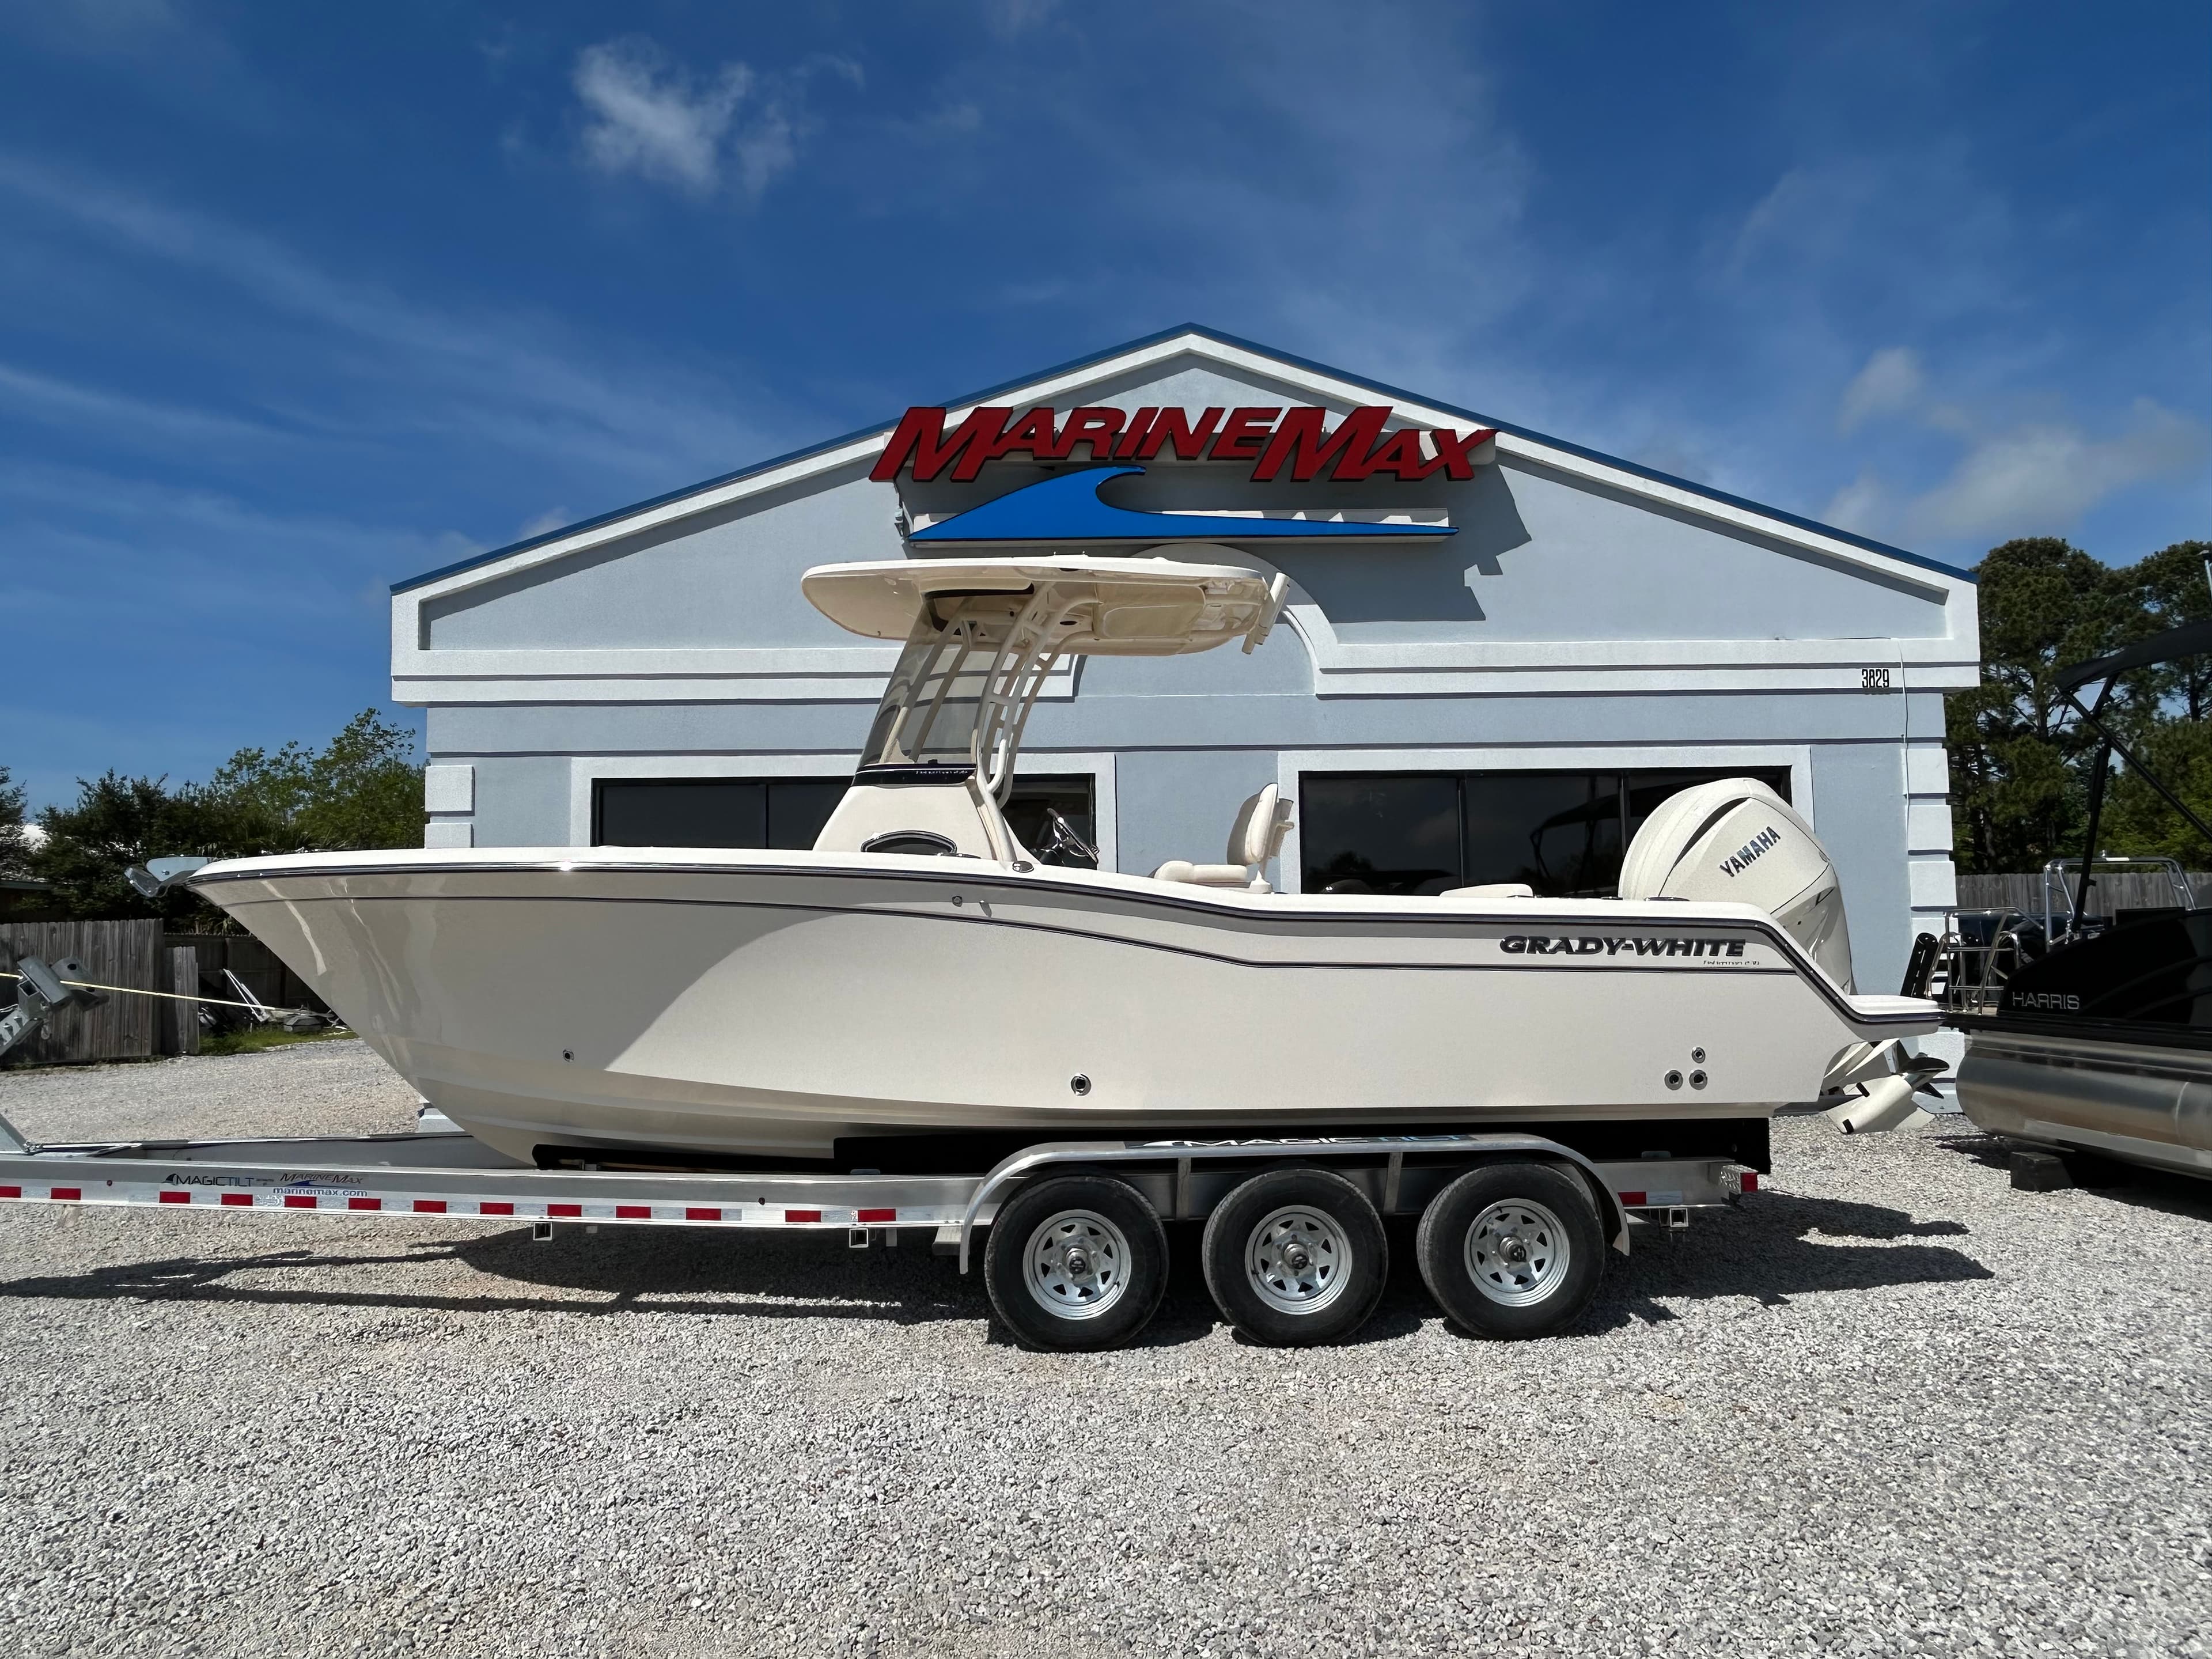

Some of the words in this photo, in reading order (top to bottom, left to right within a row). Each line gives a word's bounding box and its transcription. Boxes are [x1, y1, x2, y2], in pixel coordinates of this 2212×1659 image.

[1861, 669, 1889, 688] 3829
[1719, 826, 1781, 877] YAMAHA
[1499, 935, 1746, 957] GRADY-WHITE
[2012, 991, 2080, 1009] HARRIS
[176, 1175, 255, 1187] MAGICTILT
[272, 1188, 368, 1197] marinemax.com
